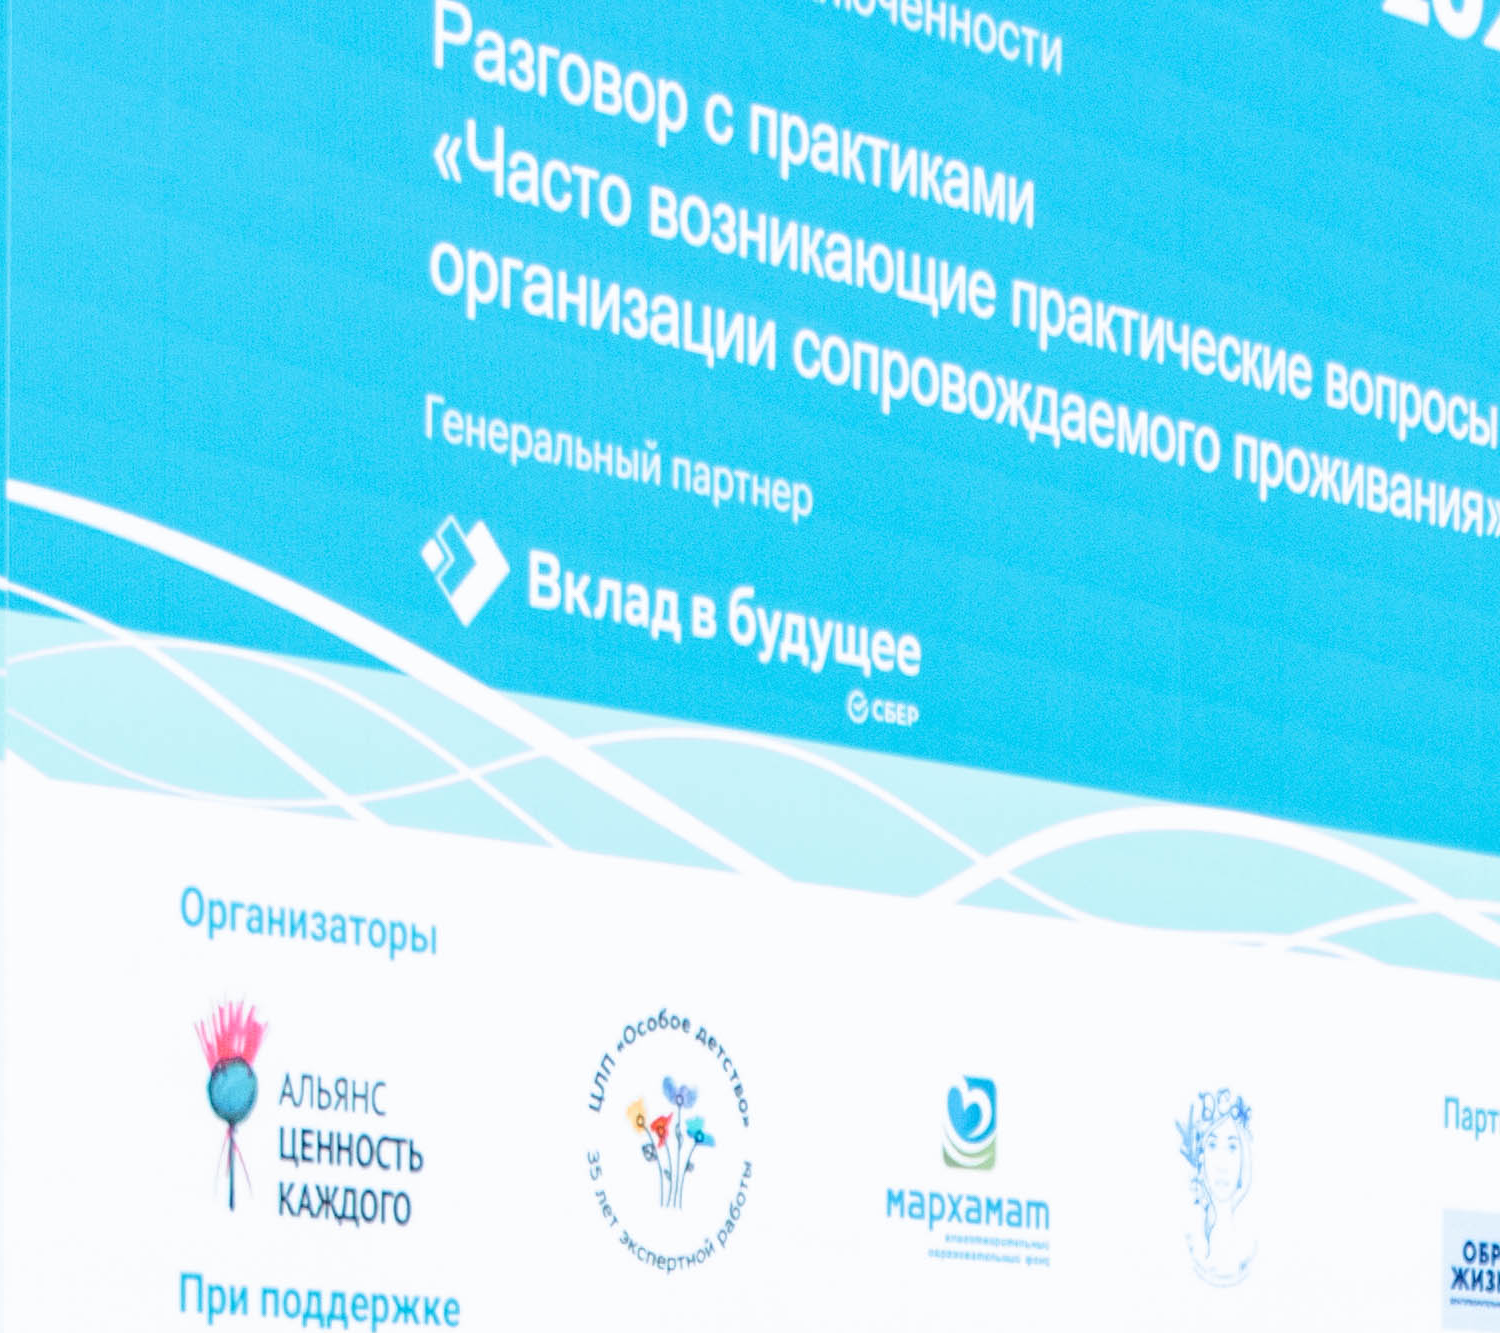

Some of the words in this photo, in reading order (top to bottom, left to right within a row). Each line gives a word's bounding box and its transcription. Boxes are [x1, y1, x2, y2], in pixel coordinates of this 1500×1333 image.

[432, 0, 688, 146] Разговор
[705, 93, 734, 145] с
[750, 103, 1035, 229] практиками
[433, 119, 632, 226] «Часто
[648, 178, 997, 319] возникающие
[1011, 276, 1312, 399] практические
[1325, 366, 1499, 451] вопросы
[429, 238, 778, 370] организации
[792, 328, 1221, 476] сопровождаемого
[424, 394, 661, 485] Генеральный
[672, 454, 814, 523] партнер
[527, 552, 680, 640] Вклад
[692, 590, 718, 640] в
[729, 587, 921, 676] будущее
[180, 886, 437, 960] Организаторы
[279, 1073, 387, 1116] АЛЬЯНС
[588, 1053, 616, 1112] ЦЛП
[279, 1127, 424, 1173] ЦЕННОСТЬ
[279, 1182, 411, 1226] КАЖДОГО
[587, 1150, 602, 1180] 35
[596, 1189, 619, 1227] лет
[620, 1230, 715, 1274] экспертной
[718, 1160, 752, 1248] работы
[886, 1187, 1049, 1231] мархамат
[178, 1271, 250, 1325] При
[261, 1284, 460, 1333] поддержке
